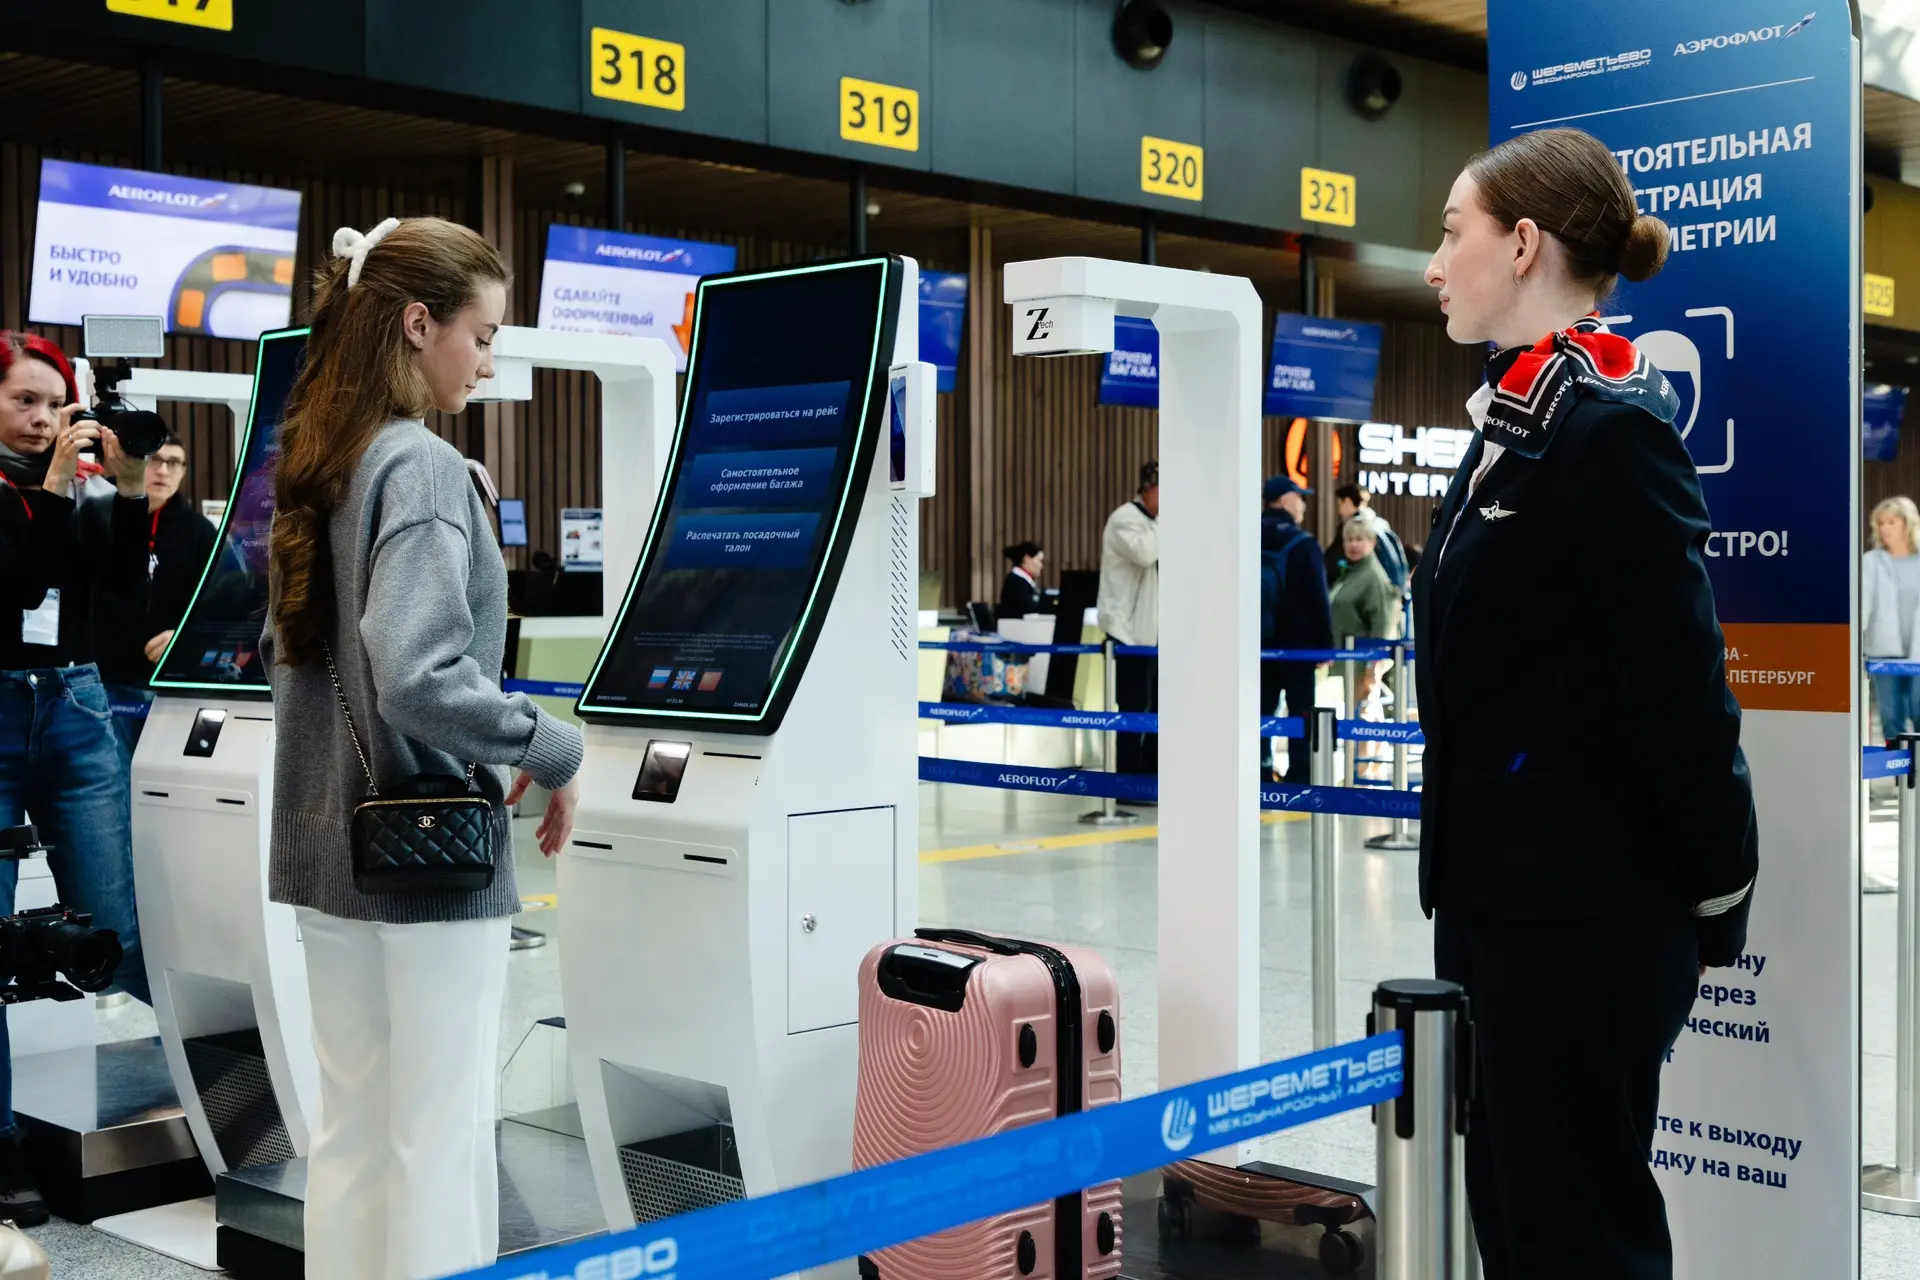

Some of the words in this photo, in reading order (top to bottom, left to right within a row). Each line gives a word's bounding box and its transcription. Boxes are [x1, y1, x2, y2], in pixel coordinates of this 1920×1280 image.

[1673, 24, 1785, 56] АЭРОФЛОТ
[600, 43, 677, 96] 318
[1532, 48, 1652, 79] ШЕРЕМЕТЬЕВО
[1606, 59, 1652, 73] АЭРОПОРТ
[848, 91, 912, 136] 319
[1610, 122, 1812, 174] ТОЯТЕЛЬНАЯ
[1147, 148, 1198, 188] 320
[108, 184, 200, 208] AEROFLOT
[1309, 179, 1348, 215] 321
[50, 245, 121, 265] БЫСТРО
[50, 267, 63, 282] И
[68, 268, 138, 290] УДОБНО
[710, 410, 800, 425] Зарегистрироваться
[802, 408, 813, 418] на
[815, 405, 839, 418] рейс
[720, 466, 800, 478] Самостоятельное
[1358, 471, 1453, 497] INTER
[710, 480, 768, 493] оформление
[769, 478, 804, 490] багажа
[686, 531, 741, 542] Распечатать
[742, 528, 800, 541] посадочный
[1704, 530, 1788, 558] СТРО!
[724, 543, 752, 553] талон
[929, 707, 970, 718] AEROFLOT
[1061, 715, 1107, 726] AEROFLOT
[1351, 727, 1408, 739] AEROFLOT
[998, 774, 1058, 787] AEROFLOT
[1729, 953, 1766, 977] ну
[1694, 983, 1757, 1007] ерез
[1689, 1120, 1703, 1138] к
[1708, 1124, 1802, 1161] выходу
[1702, 1158, 1730, 1178] на
[1737, 1164, 1787, 1189] ваш
